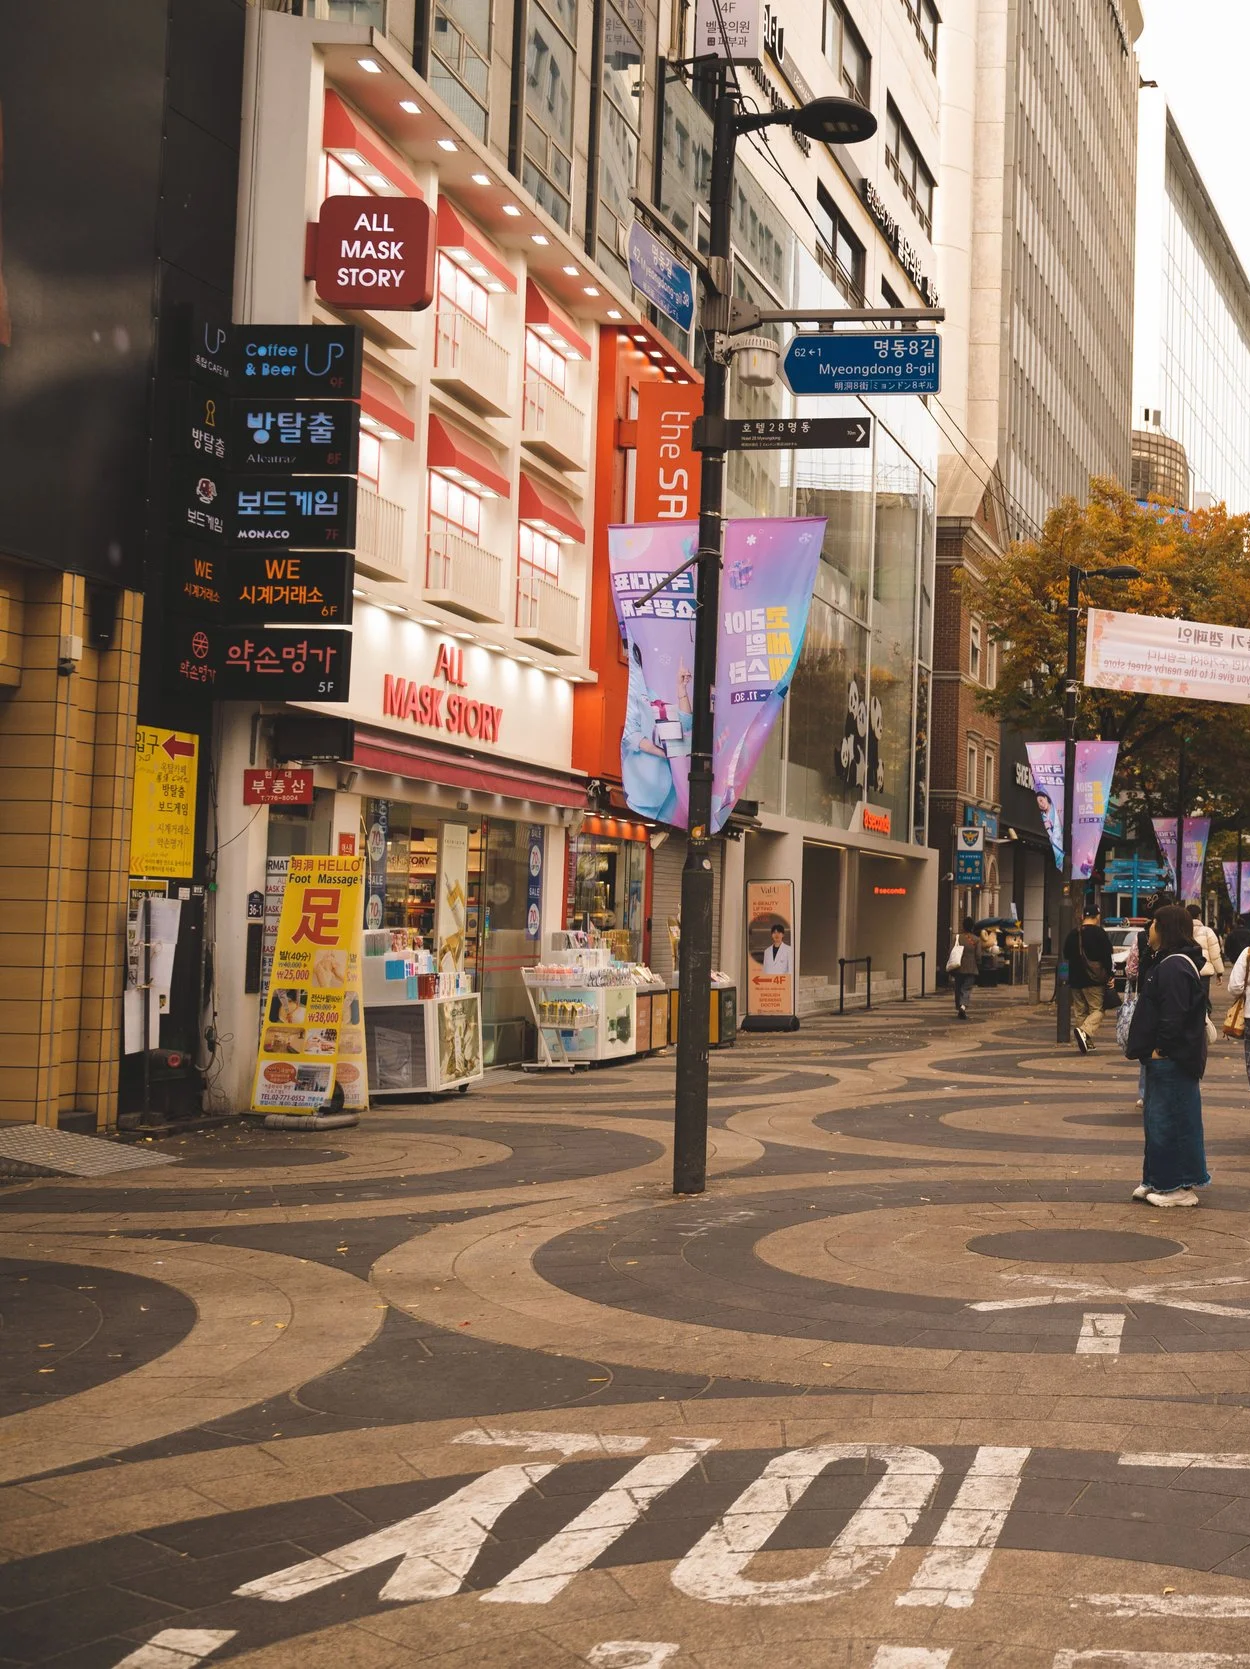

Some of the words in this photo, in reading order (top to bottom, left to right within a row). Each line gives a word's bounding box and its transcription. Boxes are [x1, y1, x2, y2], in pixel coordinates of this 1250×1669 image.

[721, 2, 736, 13] 4F
[354, 213, 394, 233] ALL
[340, 240, 404, 260] MASK
[336, 268, 405, 288] STORY
[246, 343, 298, 358] Coffee
[794, 348, 806, 358] 62
[873, 339, 936, 359] 명동8길
[245, 363, 257, 376] &
[262, 363, 297, 377] Beer
[819, 363, 902, 377] Myeongdong
[905, 362, 935, 376] 8-gil
[247, 411, 335, 445] 방탈출
[191, 426, 225, 458] 방탈출
[246, 453, 297, 464] Alcatraz
[237, 490, 338, 516] 보드게임
[187, 507, 224, 533] 보드게임
[237, 529, 290, 539] MONACO
[194, 559, 214, 580] WE
[265, 559, 301, 579] WE
[184, 582, 221, 603] 시계거래소
[239, 585, 324, 605] 시계거래소
[321, 605, 338, 617] 6F
[225, 640, 337, 674] 약손명가
[179, 660, 216, 684] 약손명가
[434, 643, 467, 687] ALL
[318, 682, 334, 693] 5F
[384, 674, 444, 728] MASK
[446, 694, 503, 742] STORY
[162, 784, 186, 799] 방탈출
[157, 801, 188, 816] 보드게임
[318, 859, 360, 872] HELLO
[289, 873, 311, 884] Foot
[318, 874, 358, 887] Massage
[368, 875, 383, 885] SALE
[131, 889, 146, 898] Nice
[529, 887, 540, 896] SALE
[248, 904, 262, 915] 36-1
[291, 888, 341, 946] 足
[773, 976, 786, 985] 4F
